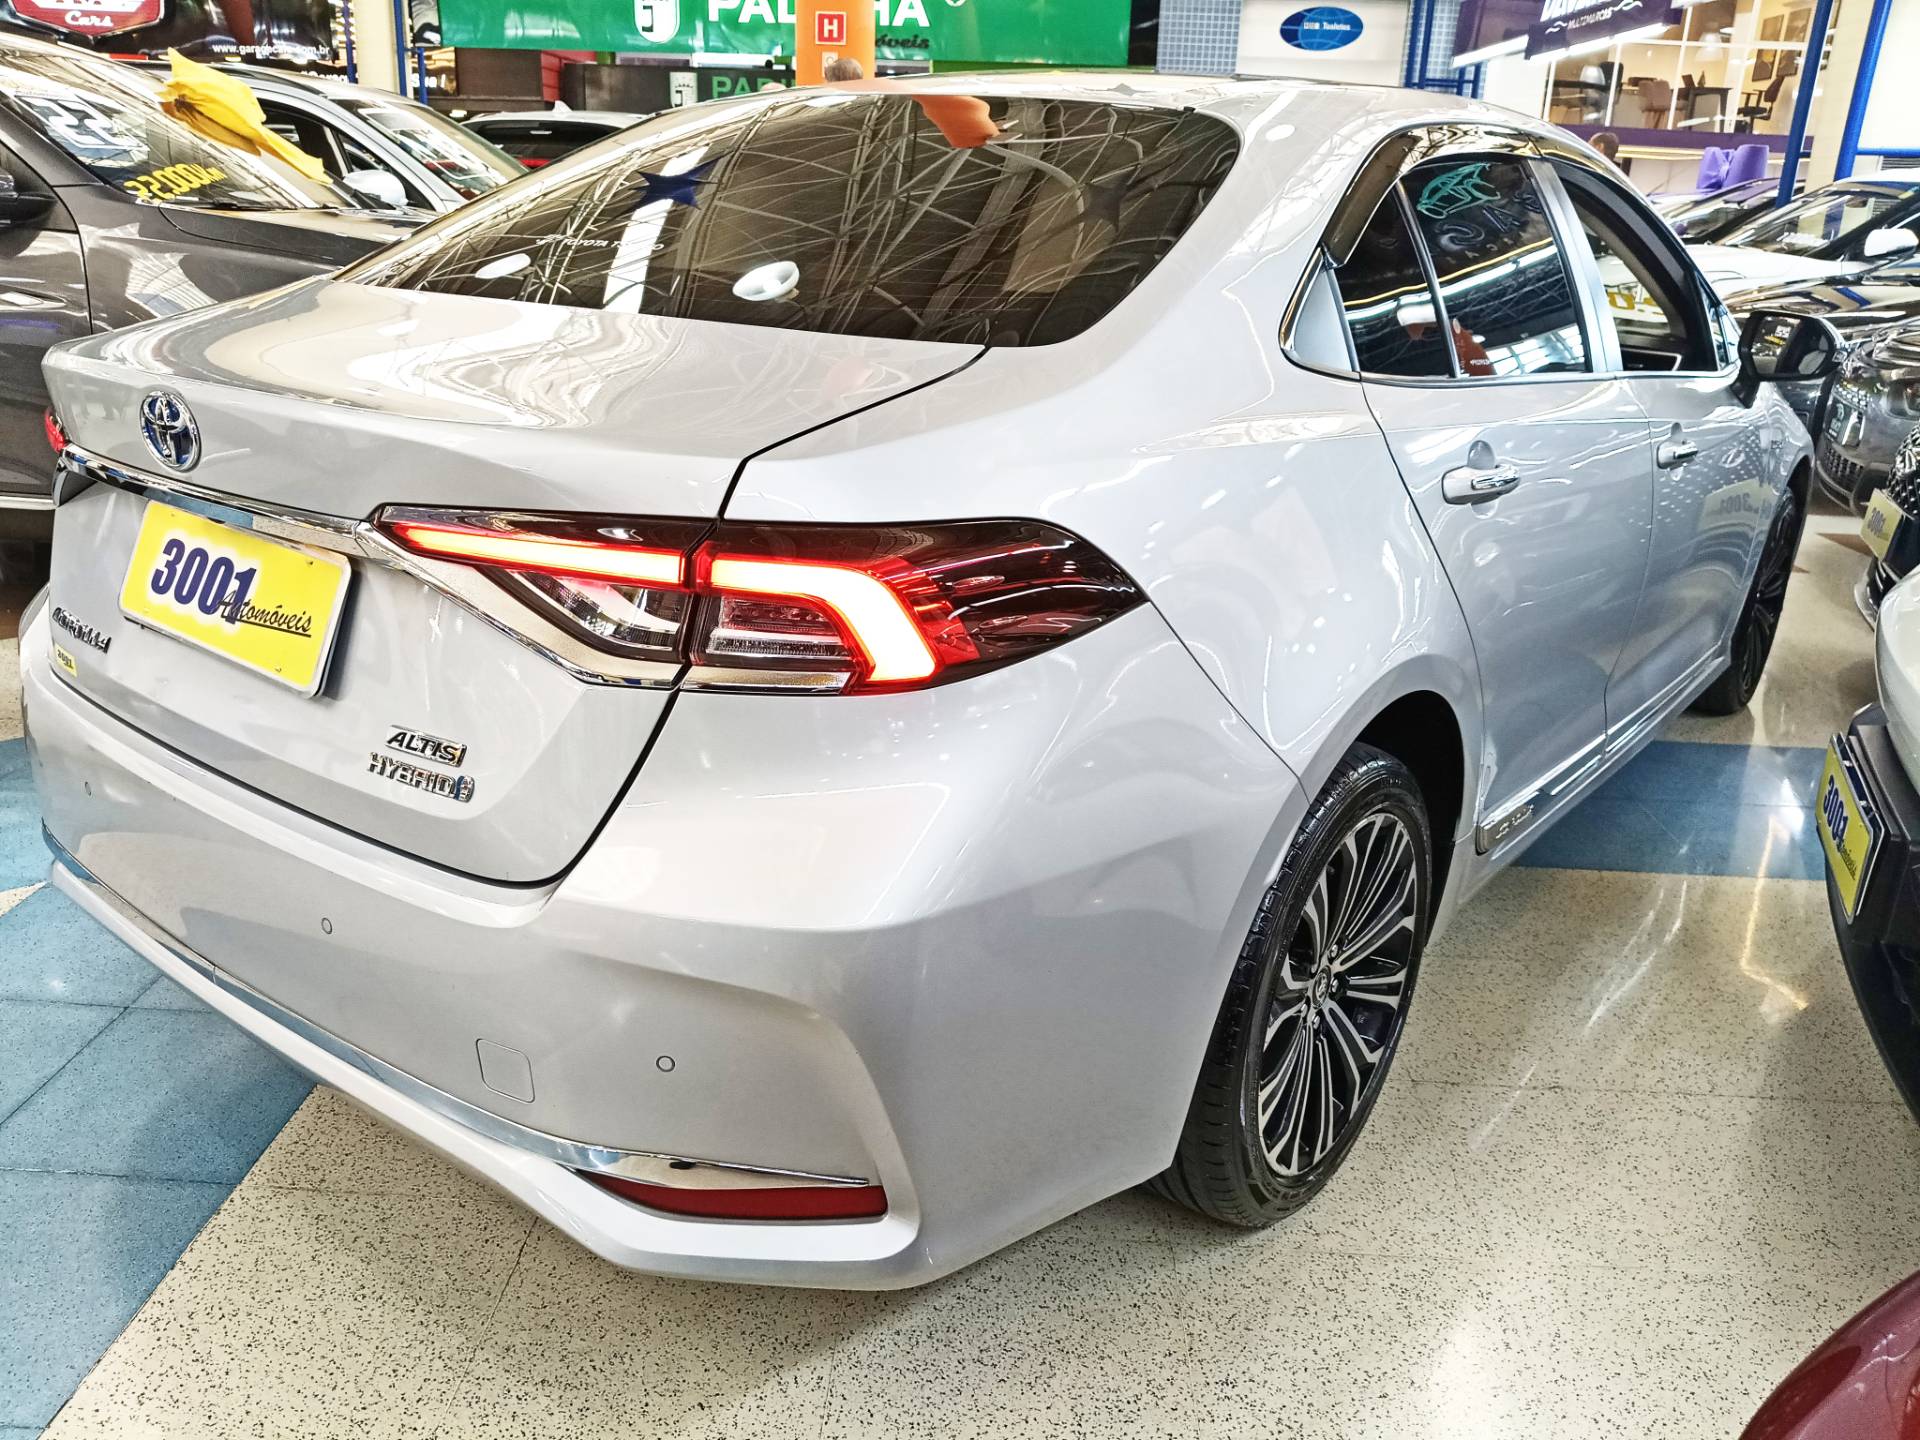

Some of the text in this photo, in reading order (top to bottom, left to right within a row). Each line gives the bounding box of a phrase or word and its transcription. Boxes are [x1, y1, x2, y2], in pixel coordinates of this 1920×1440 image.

[64, 11, 114, 27] Cars
[151, 538, 257, 624] 3001
[217, 590, 312, 637] Automóveis
[386, 731, 460, 763] ALTIS
[366, 751, 457, 798] HYBRID
[1823, 774, 1848, 853] 3001
